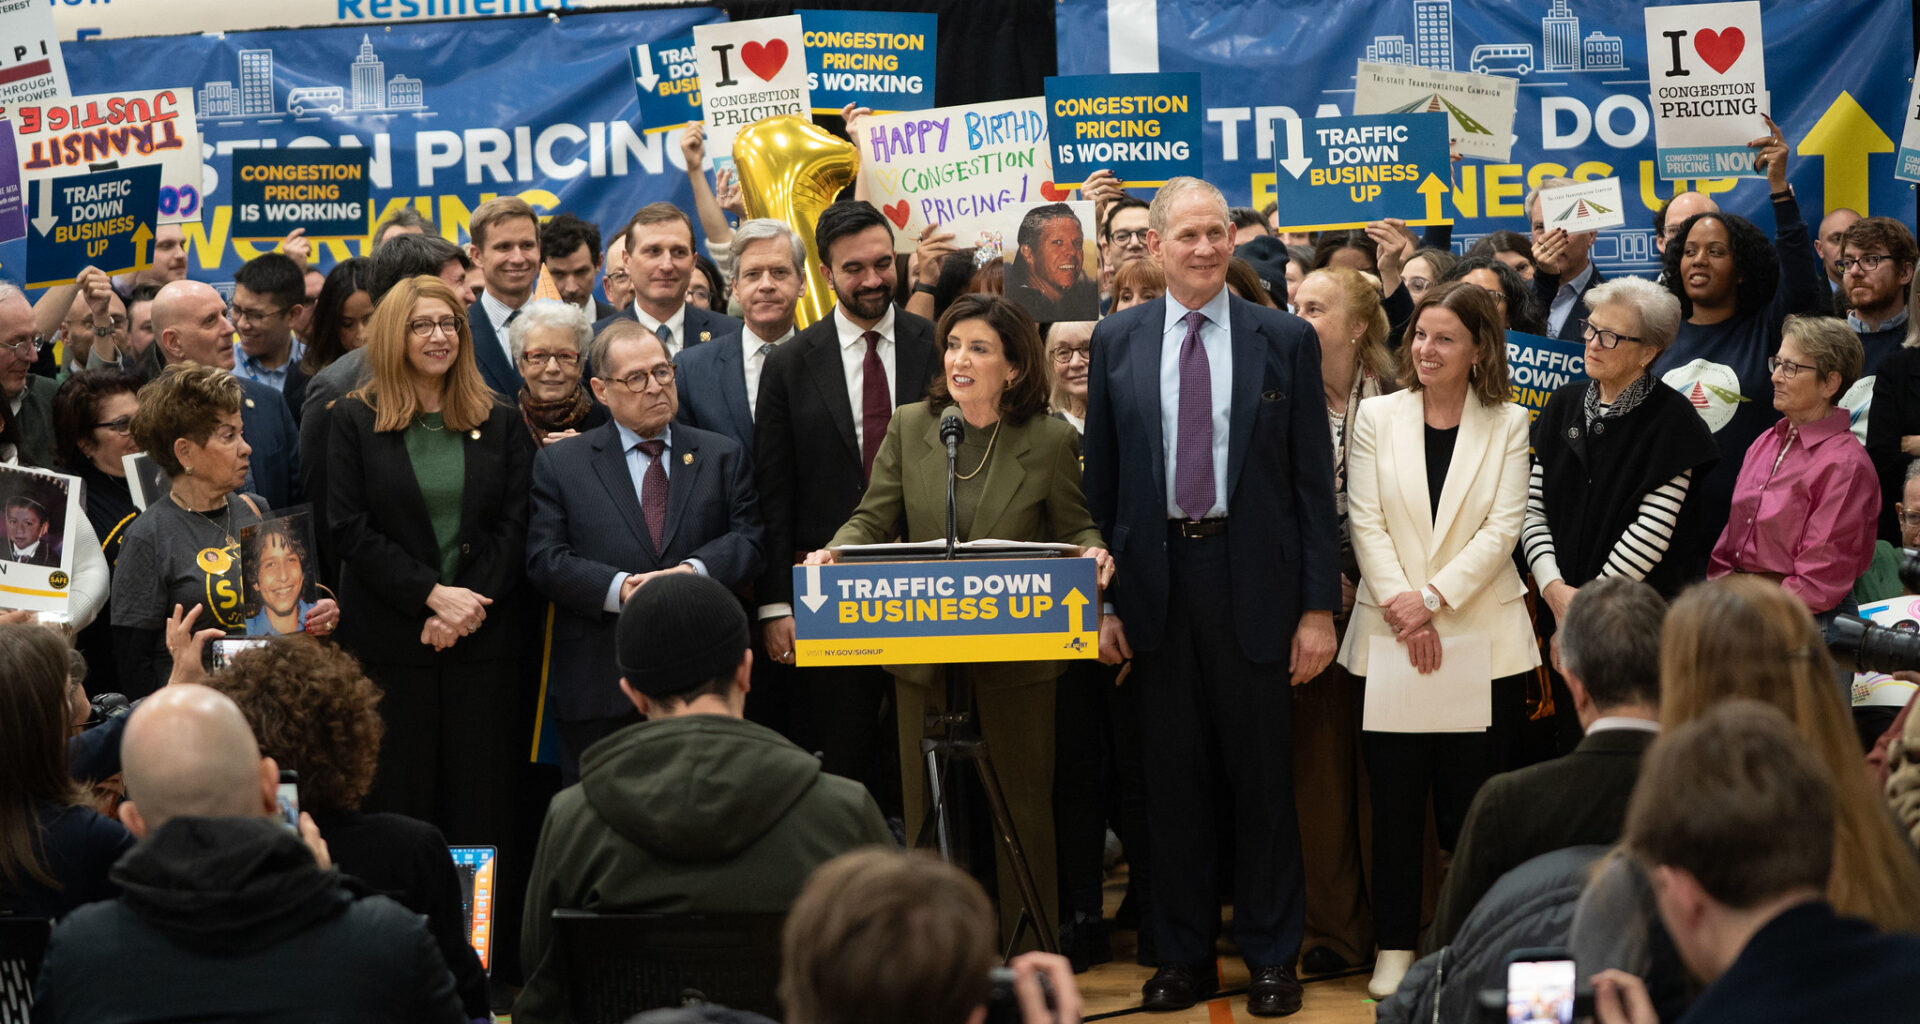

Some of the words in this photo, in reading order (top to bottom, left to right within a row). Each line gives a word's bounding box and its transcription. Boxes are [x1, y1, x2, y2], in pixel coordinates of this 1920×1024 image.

[803, 31, 924, 51] CONGESTION
[823, 53, 898, 71] PRICING
[1662, 30, 1690, 77] I
[711, 43, 738, 87] I
[0, 76, 55, 97] HROUGH
[807, 72, 819, 90] S
[823, 73, 923, 94] WORKING
[1408, 78, 1464, 92] TRANSPORTATION
[1467, 85, 1501, 97] CAMPAIGN
[1658, 82, 1755, 98] CONGESTION
[18, 87, 57, 103] POWER
[710, 88, 800, 108] CONGESTION
[19, 91, 179, 134] JUSTICE
[1055, 95, 1188, 117] CONGESTION
[1660, 98, 1757, 118] PRICING
[1076, 120, 1161, 139] PRICING
[1316, 125, 1408, 146] TRAFFIC
[24, 120, 184, 170] TRANSIT
[870, 117, 950, 163] HAPPY
[1058, 144, 1074, 164] IS
[1077, 141, 1190, 163] WORKING
[1328, 145, 1399, 165] DOWN
[1665, 153, 1709, 162] CONGESTION
[241, 164, 361, 181] CONGESTION
[902, 147, 1035, 193] CONGESTION
[1310, 164, 1419, 186] BUSINESS
[1666, 161, 1711, 174] PRICING
[64, 179, 132, 204] TRAFFIC
[264, 185, 340, 200] PRICING
[1350, 185, 1381, 203] UP
[71, 199, 123, 223] DOWN
[240, 204, 260, 221] IS
[265, 203, 361, 221] WORKING
[55, 215, 134, 243] BUSINESS
[86, 239, 109, 257] UP
[1505, 342, 1585, 374] RAFFIC
[50, 576, 67, 584] SAFE
[837, 575, 955, 599] TRAFFIC
[963, 573, 1051, 597] DOWN
[838, 597, 999, 624] BUSINESS
[1009, 595, 1053, 619] UP
[824, 648, 884, 656] NY.GOV/SIGNUP
